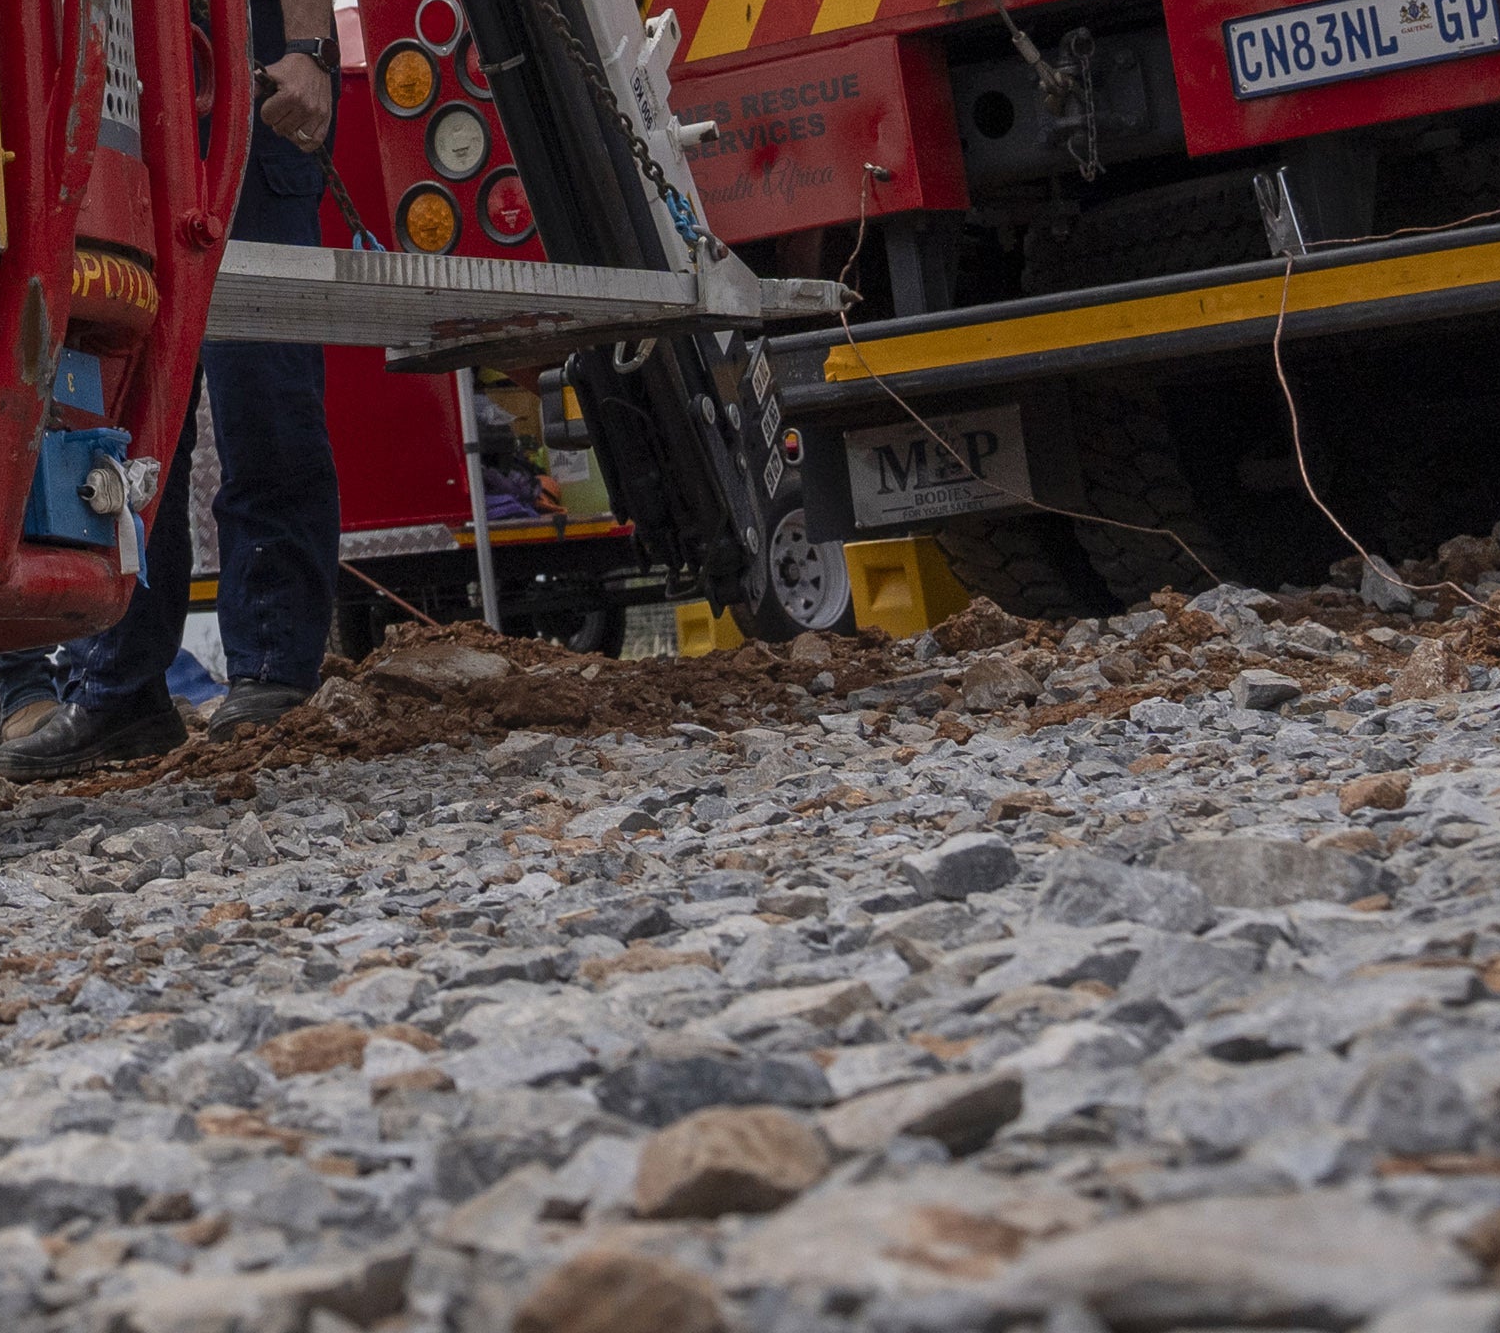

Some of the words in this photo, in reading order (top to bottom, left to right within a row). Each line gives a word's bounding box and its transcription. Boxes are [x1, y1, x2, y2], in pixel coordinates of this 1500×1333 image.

[1401, 22, 1433, 35] GAUTENG
[1236, 5, 1399, 82] CN83NL
[634, 77, 644, 102] KG
[675, 101, 733, 126] NES
[741, 73, 860, 119] RESCUE
[641, 100, 653, 130] 900
[872, 429, 998, 496] M&P
[902, 509, 922, 520] FOR
[922, 505, 949, 518] YOUR
[950, 500, 985, 516] SAFETY
[914, 487, 972, 507] BODIES
